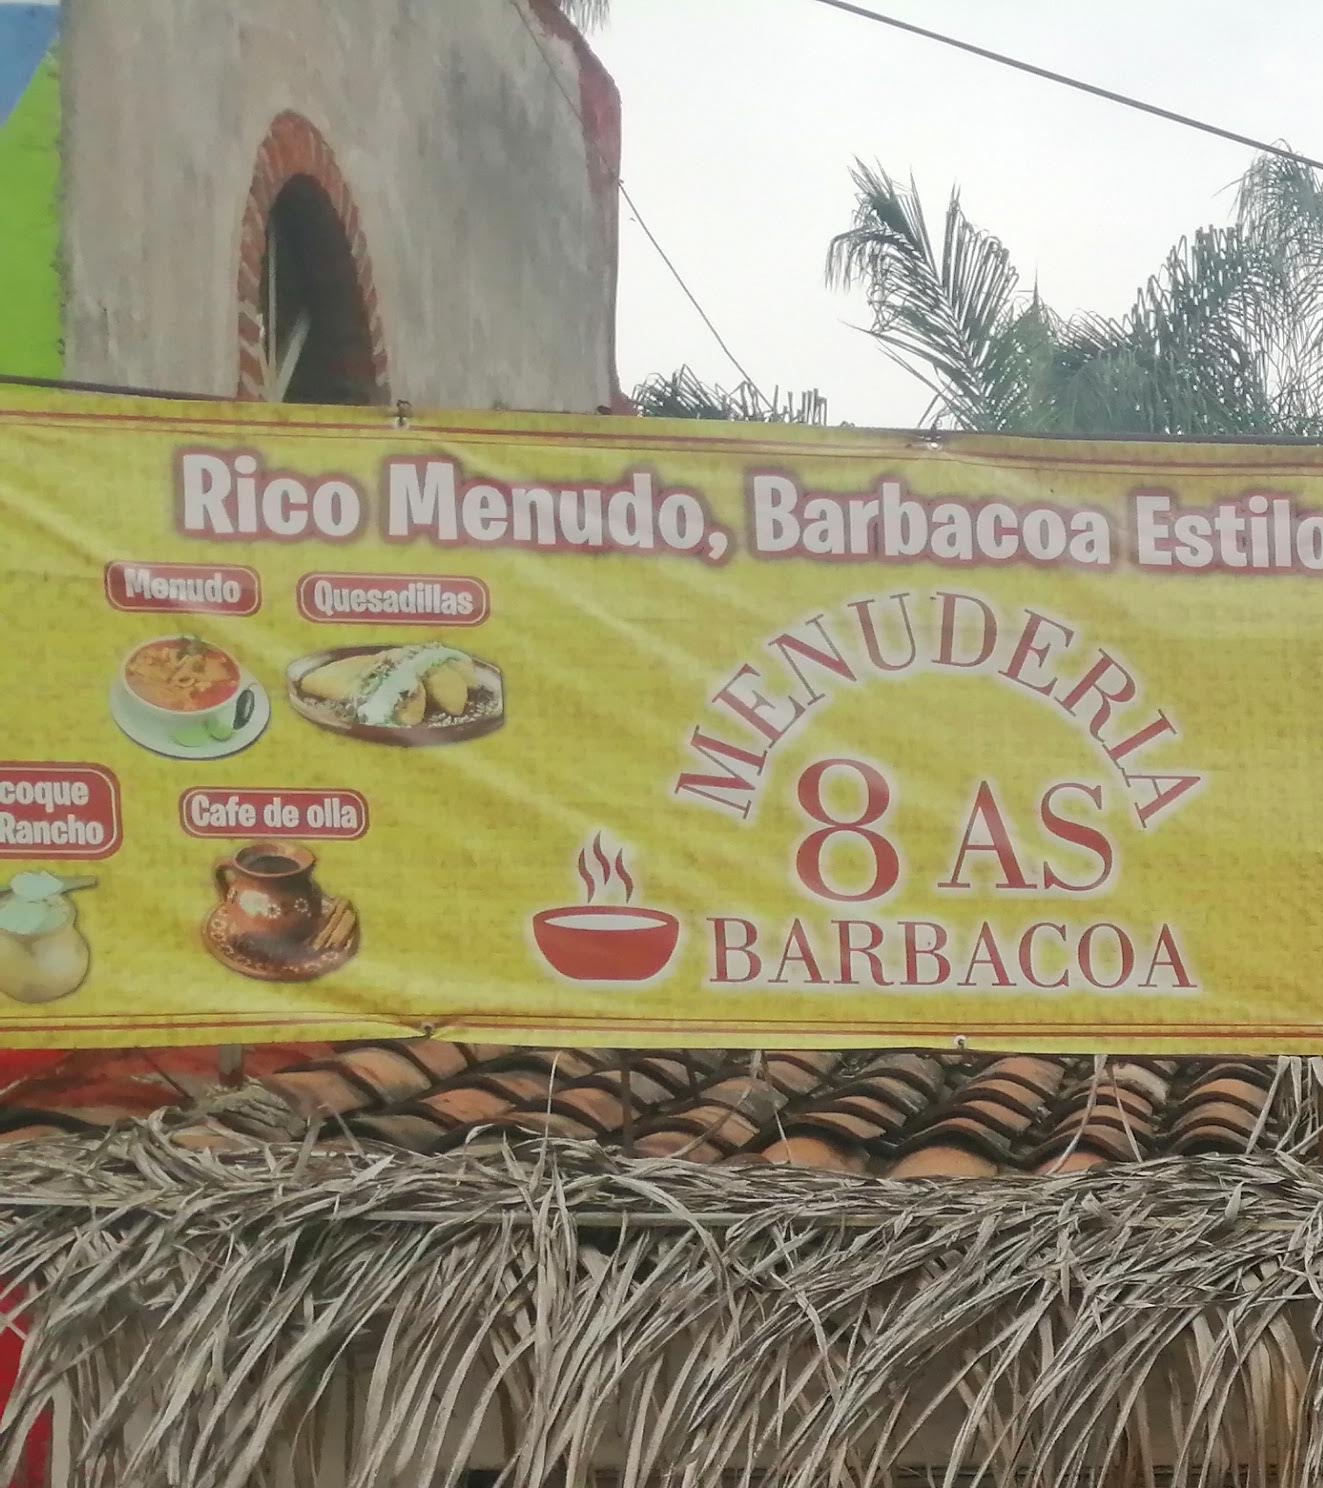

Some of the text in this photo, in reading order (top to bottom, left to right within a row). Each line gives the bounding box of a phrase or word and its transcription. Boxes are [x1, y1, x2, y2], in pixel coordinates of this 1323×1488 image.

[180, 453, 362, 538] Rico
[387, 461, 730, 561] Menudo,
[752, 470, 1111, 568] Barbacoa
[124, 566, 242, 606] Menudo
[313, 580, 475, 617] Quesadillas
[673, 590, 1202, 830] MENUDERIA
[0, 811, 105, 845] Rancho
[190, 794, 357, 829] Cafe de olla
[795, 757, 1115, 903] 8 AS
[705, 916, 1199, 989] BARBACOA
